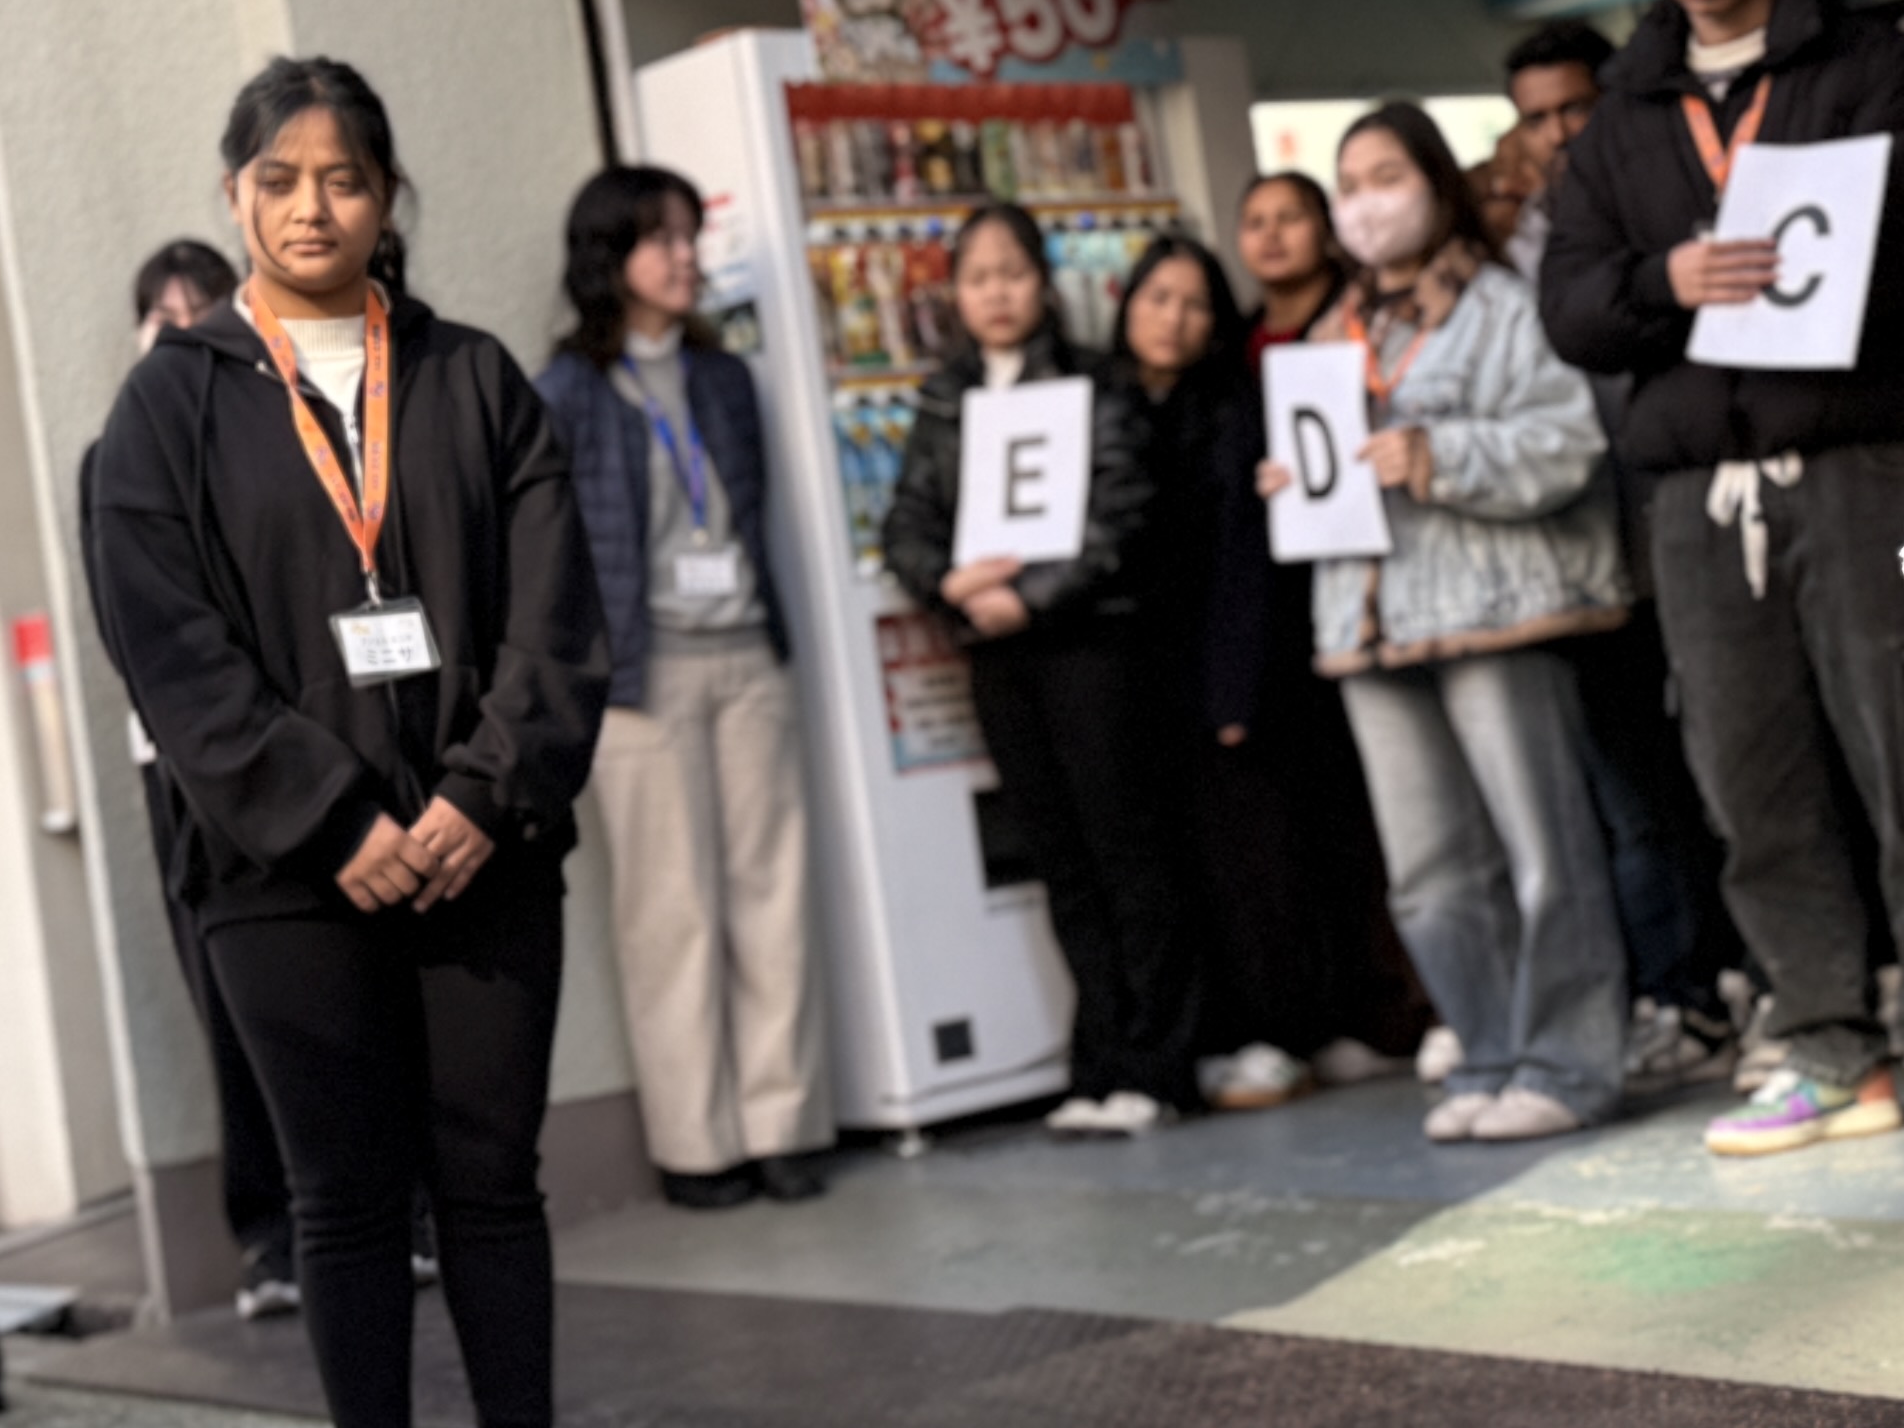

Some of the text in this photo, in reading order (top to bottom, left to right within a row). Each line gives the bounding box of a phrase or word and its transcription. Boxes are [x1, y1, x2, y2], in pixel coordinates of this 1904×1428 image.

[1761, 204, 1830, 309] C
[1006, 435, 1048, 518] E
[1292, 403, 1338, 498] D
